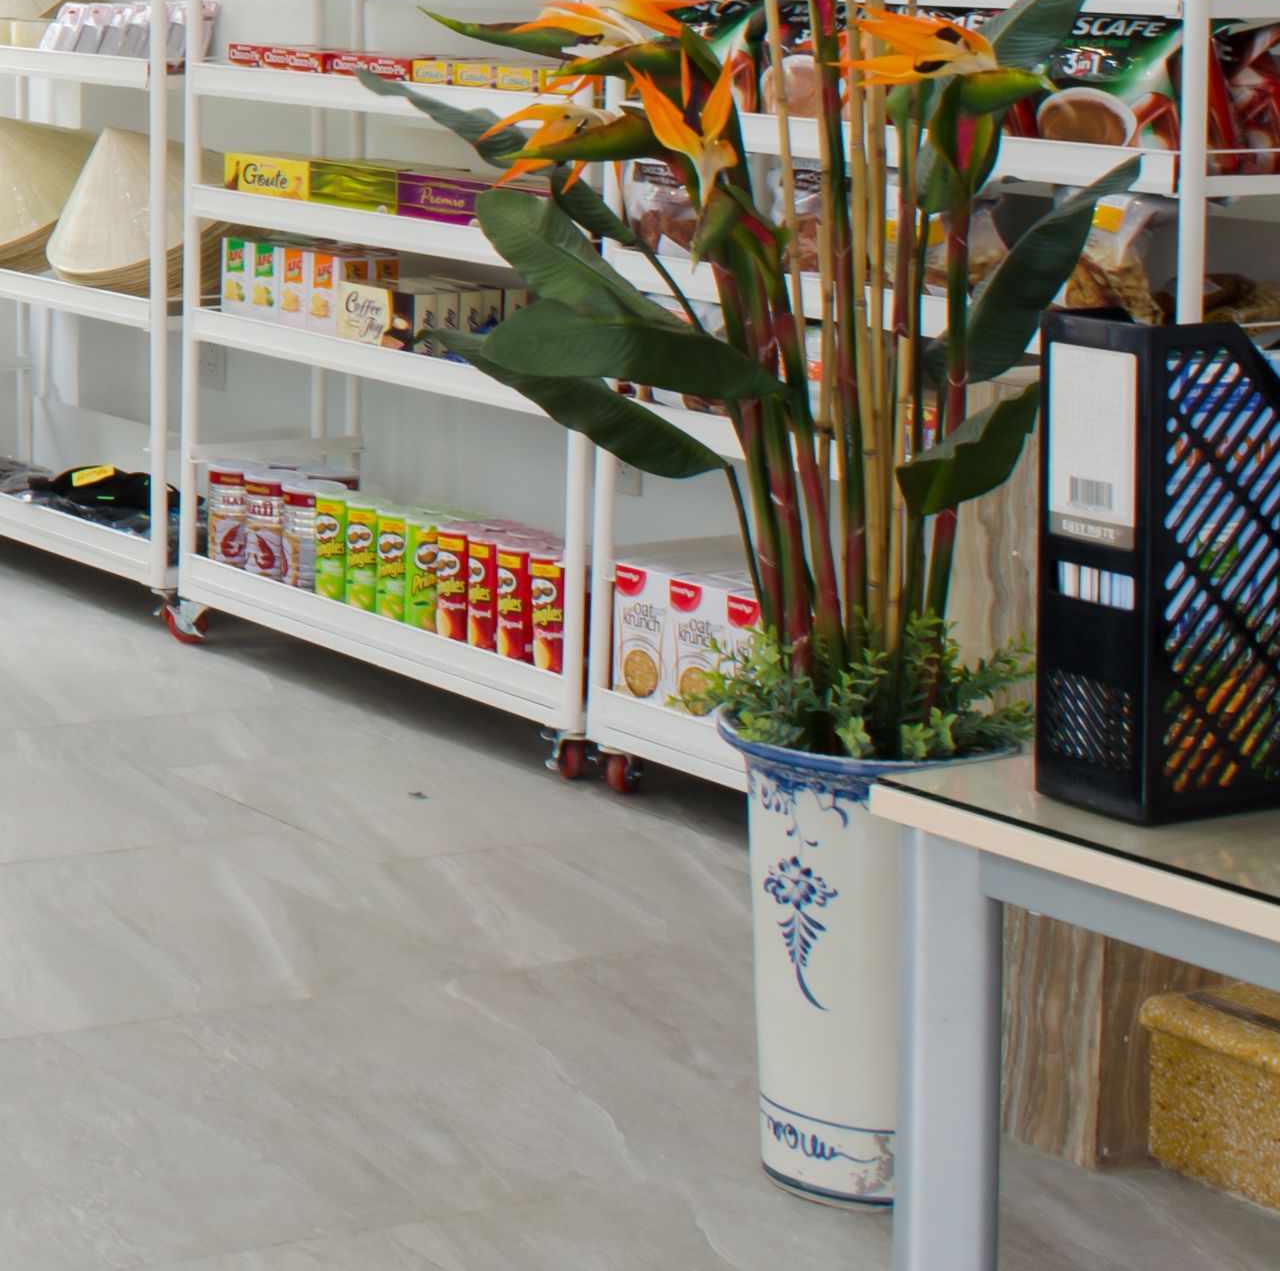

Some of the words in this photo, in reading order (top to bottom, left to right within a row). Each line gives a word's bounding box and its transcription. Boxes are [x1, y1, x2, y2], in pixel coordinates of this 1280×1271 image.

[345, 289, 382, 316] Coffee
[623, 607, 661, 633] krunch
[633, 602, 655, 619] oat
[689, 618, 711, 635] oat
